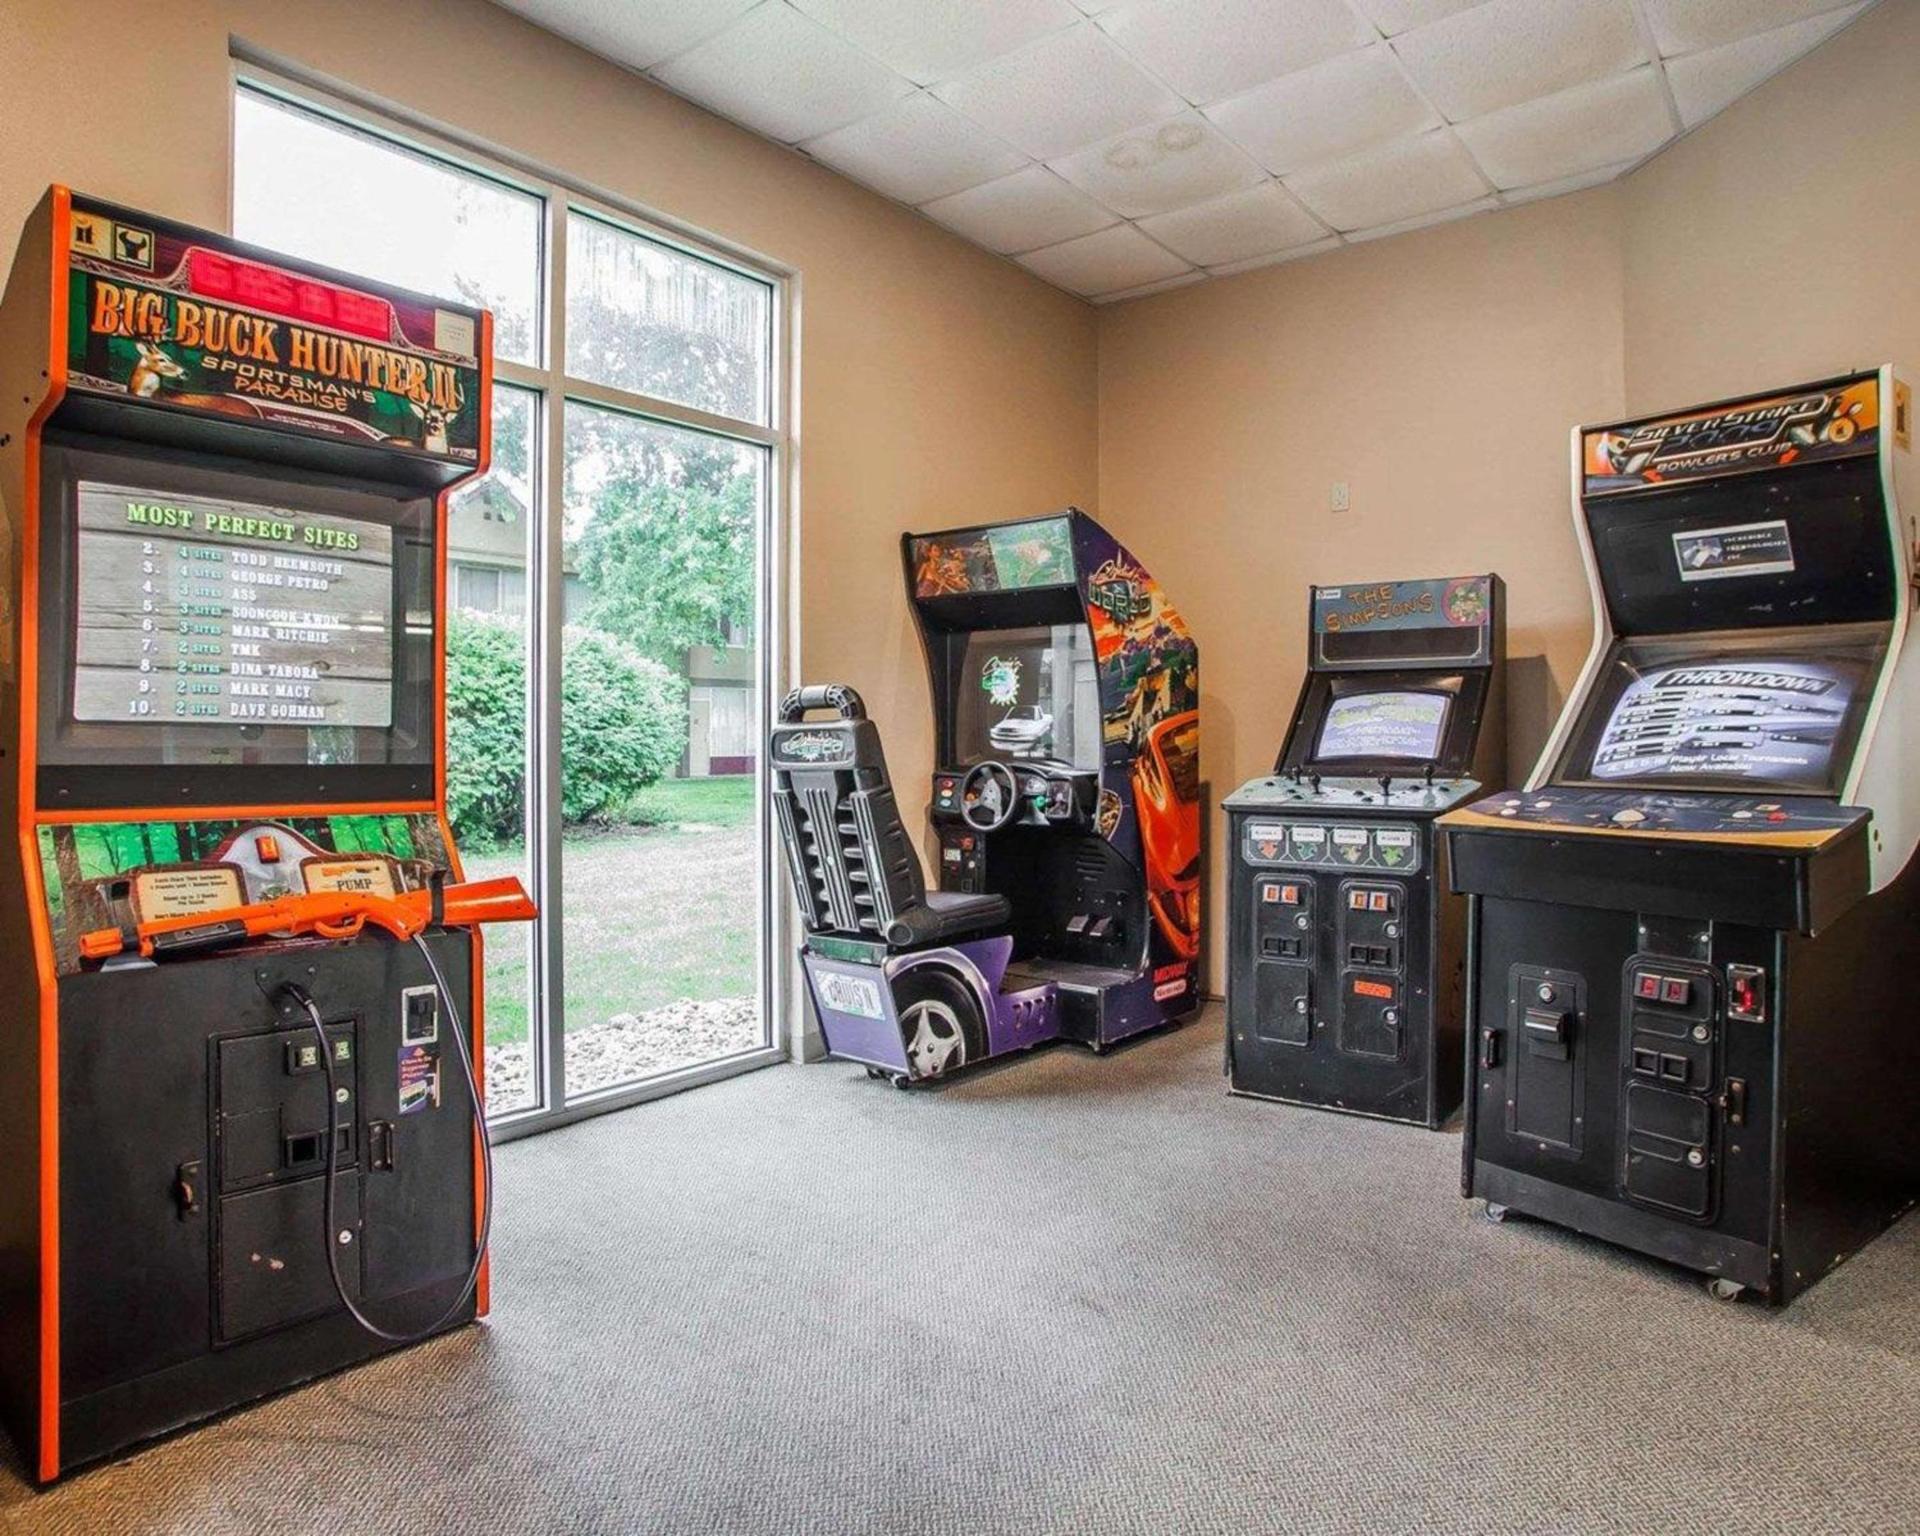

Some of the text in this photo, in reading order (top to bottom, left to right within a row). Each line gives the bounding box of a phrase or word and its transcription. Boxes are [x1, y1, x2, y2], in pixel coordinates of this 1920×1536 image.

[92, 280, 166, 335] BIG
[176, 299, 279, 360] BUCK
[289, 326, 430, 403] HUNTER
[201, 356, 376, 404] SPORTSMAN'S
[234, 376, 348, 411] PARADISE
[1656, 449, 1743, 474] BOWLER'S
[127, 503, 359, 550] MOST PERFECT SITES
[143, 542, 160, 555] 2.
[232, 551, 267, 566] TODD
[179, 566, 188, 577] 4
[231, 571, 282, 586] GEORGE
[288, 576, 329, 591] PETRO
[143, 580, 160, 593] 4.
[179, 584, 188, 596] 3
[231, 588, 256, 602] ASS
[1348, 584, 1394, 606] THE
[179, 603, 188, 615] 3
[1326, 592, 1433, 633] SIMPSONS
[179, 621, 188, 633] 3
[232, 625, 270, 638] MARK
[276, 629, 329, 643] RITCHIE
[142, 639, 158, 651] 7.
[178, 641, 188, 653] 2
[178, 661, 187, 673] 2
[230, 662, 262, 676] DINA
[269, 665, 319, 679] TABORA
[1668, 670, 1827, 692] THROWDOWN
[176, 681, 187, 694] 2
[230, 682, 270, 696] MARK
[275, 684, 311, 698] MACY
[129, 701, 156, 714] 10.
[176, 702, 186, 715] 2
[230, 702, 265, 717] DAVE
[336, 878, 372, 891] PUMP
